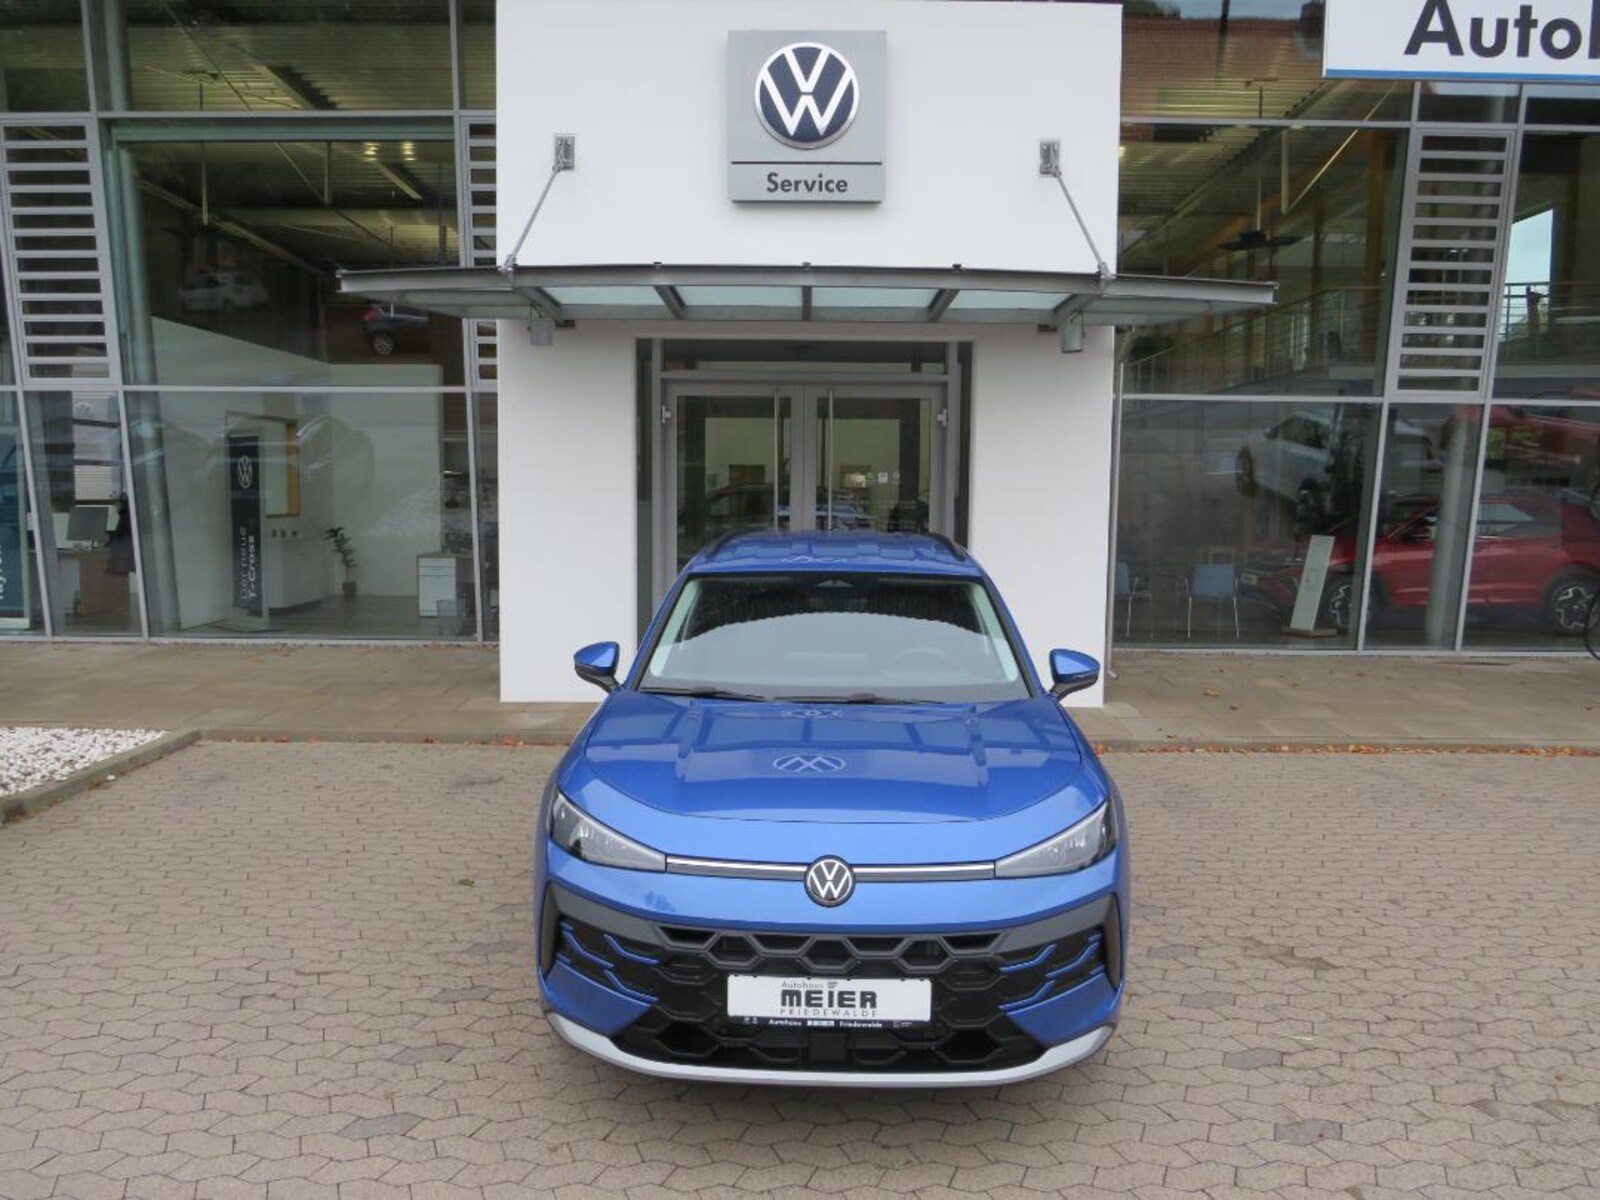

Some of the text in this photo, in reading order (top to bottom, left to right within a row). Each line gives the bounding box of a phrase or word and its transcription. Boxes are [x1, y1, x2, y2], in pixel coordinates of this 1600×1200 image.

[766, 172, 848, 193] Service
[248, 535, 257, 600] T-Cross
[781, 981, 824, 989] Autohaus
[781, 989, 877, 1008] MEIER
